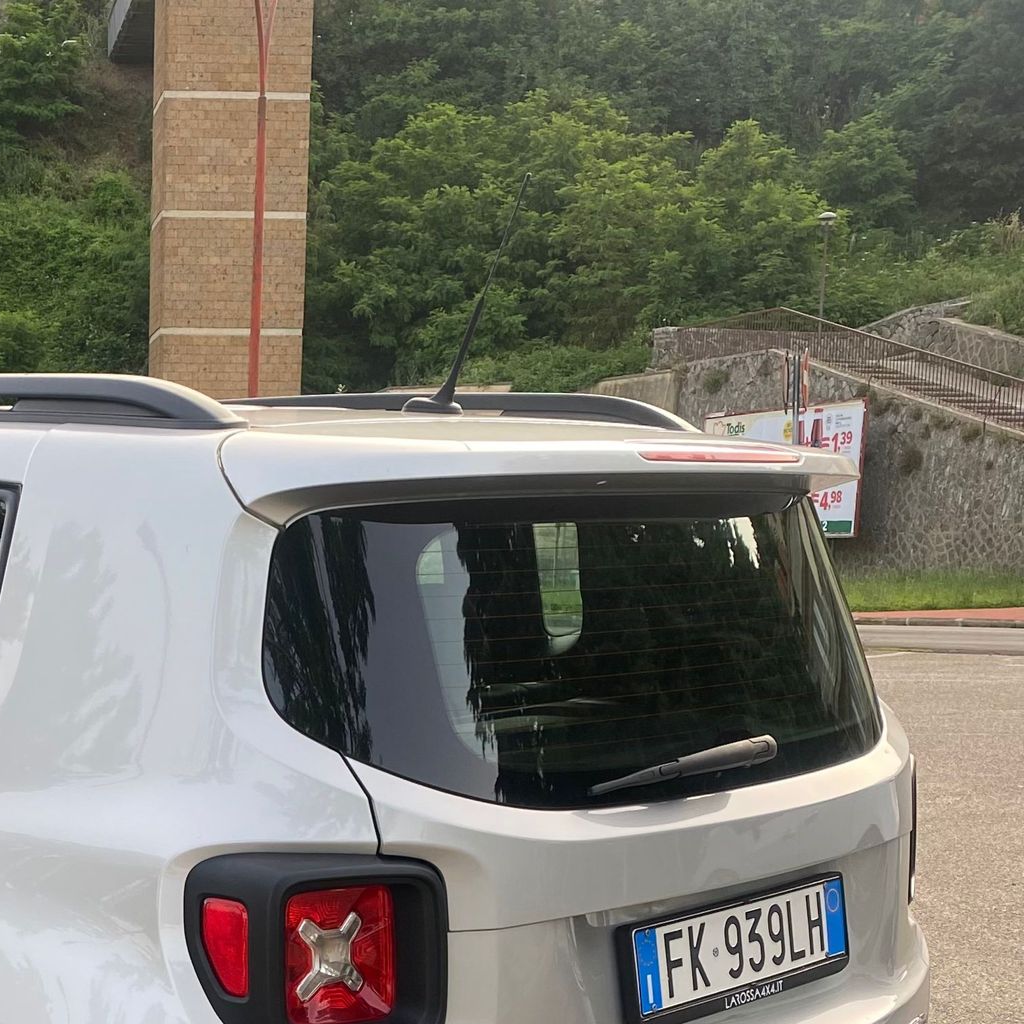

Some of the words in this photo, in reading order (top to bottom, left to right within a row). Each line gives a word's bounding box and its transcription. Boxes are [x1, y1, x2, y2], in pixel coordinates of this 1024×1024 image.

[726, 422, 745, 434] Todis
[663, 922, 710, 998] FK
[724, 890, 825, 979] 939LH
[724, 980, 783, 1009] LAROSSA4X4.IT
